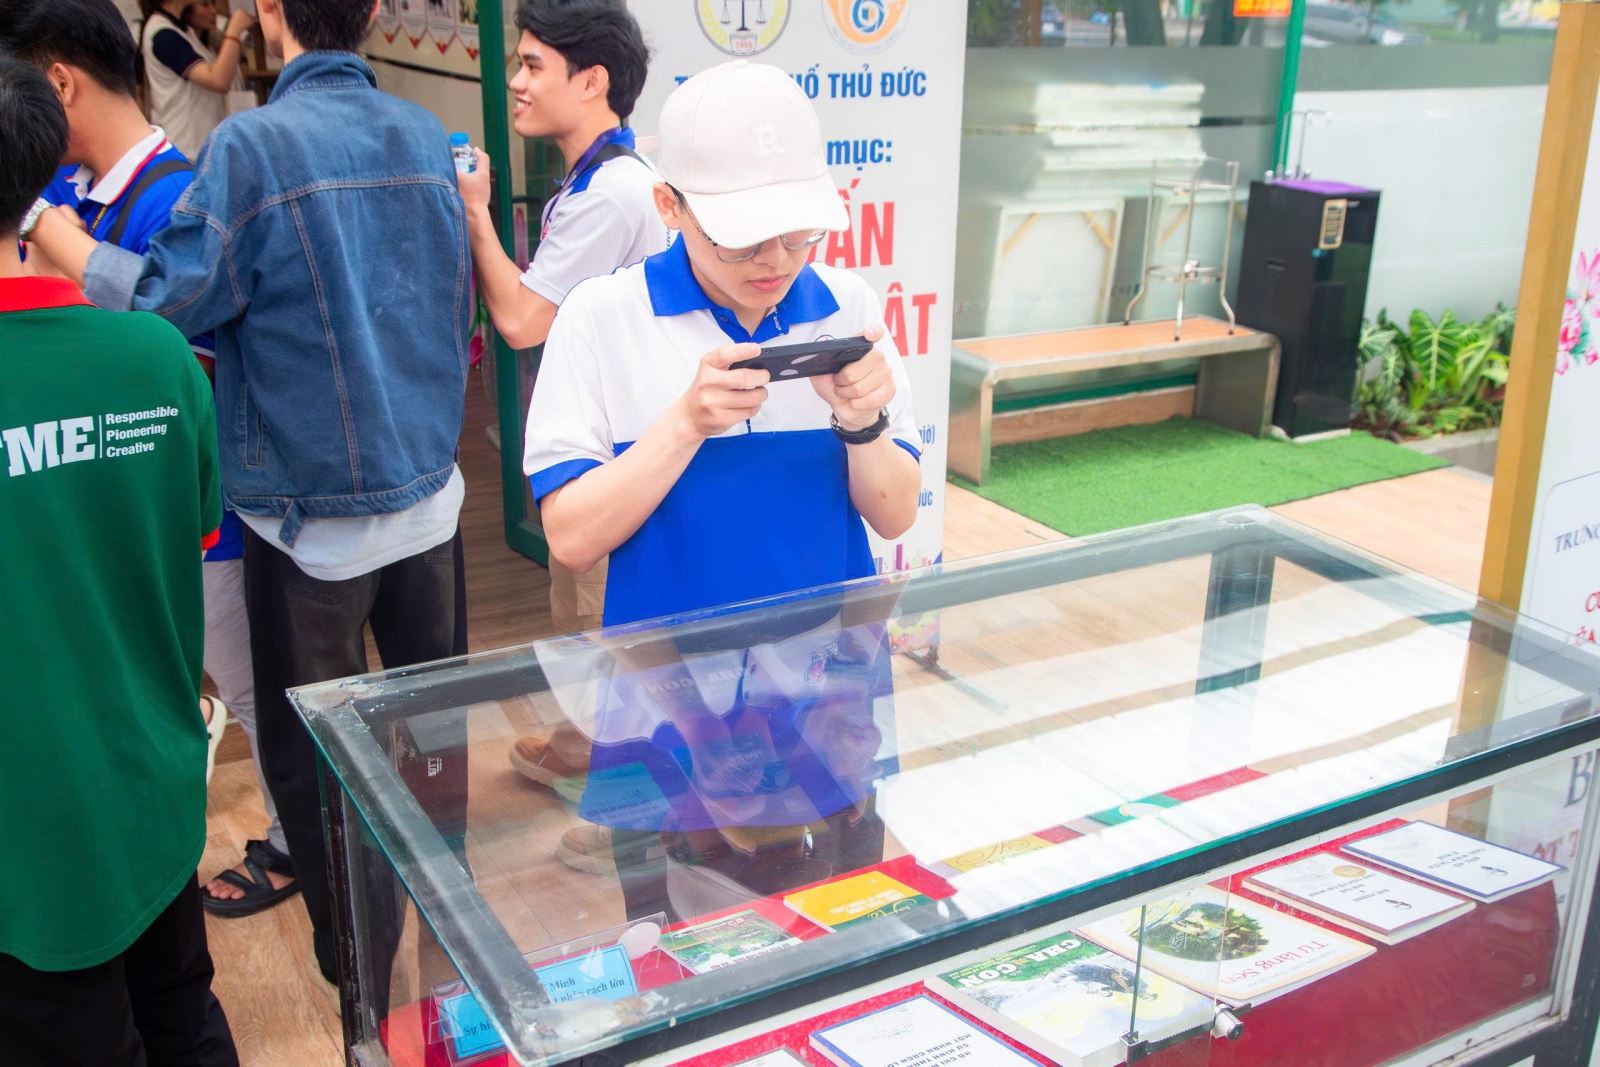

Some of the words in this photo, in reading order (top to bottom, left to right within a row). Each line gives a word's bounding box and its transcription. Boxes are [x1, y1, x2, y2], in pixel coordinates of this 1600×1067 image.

[828, 63, 872, 98] THỦ
[880, 66, 928, 97] ĐỨC
[827, 138, 893, 171] mục:
[807, 178, 895, 269] ẤN
[105, 406, 179, 425] Responsible
[106, 424, 167, 441] Pioneering
[0, 416, 96, 477] ME
[106, 442, 155, 457] Creative
[1024, 939, 1081, 962] CHA
[958, 963, 1017, 987] CON
